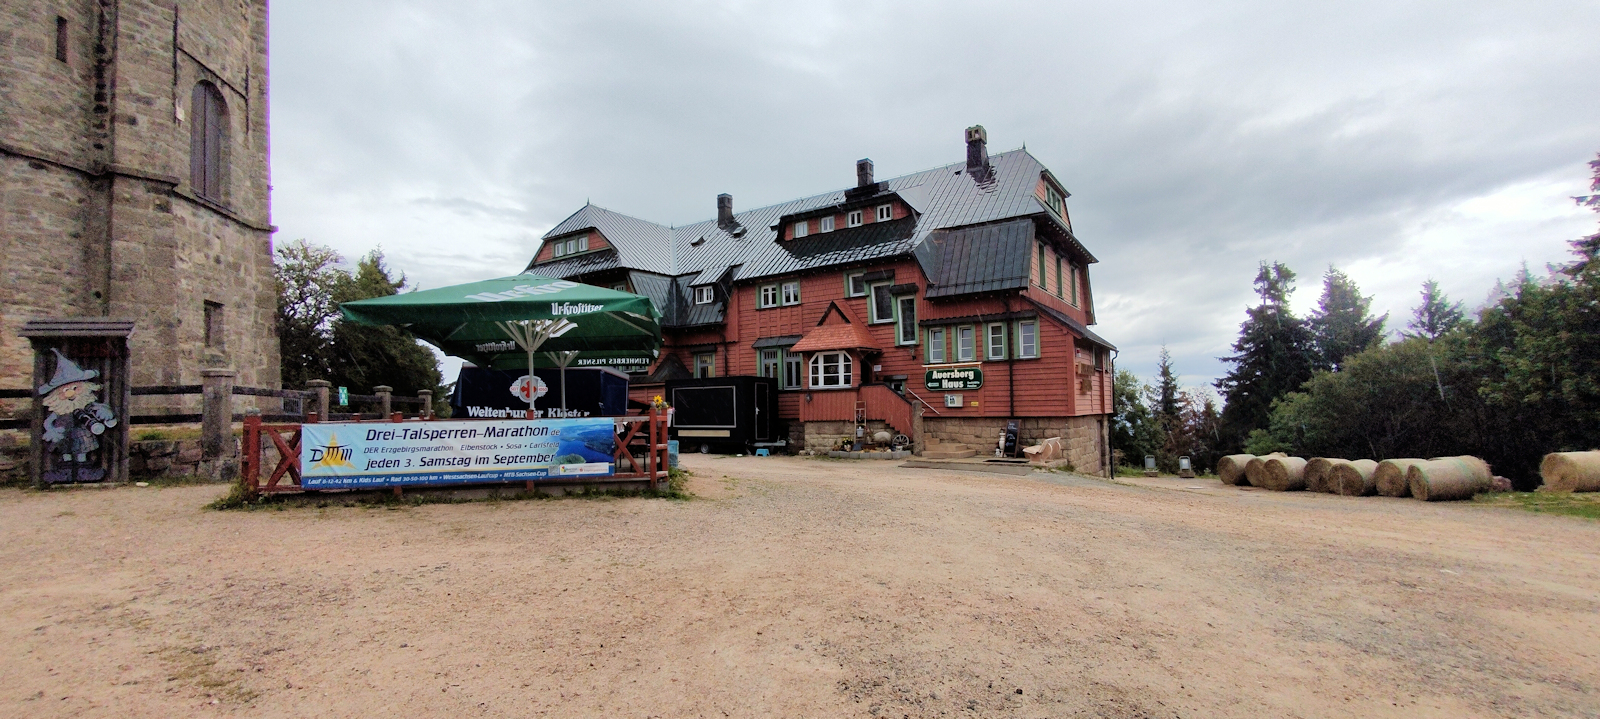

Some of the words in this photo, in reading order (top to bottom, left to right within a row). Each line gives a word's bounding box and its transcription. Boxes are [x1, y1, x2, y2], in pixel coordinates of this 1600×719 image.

[932, 369, 974, 380] Auersberg
[941, 379, 964, 389] Haus
[365, 426, 549, 441] Drei-Talsperren-Marathon
[380, 445, 454, 455] Erzgebirgsmarathon
[364, 458, 401, 471] jeden
[404, 458, 415, 468] 3.
[419, 455, 472, 467] Samstag
[475, 455, 489, 465] im
[493, 453, 555, 465] September
